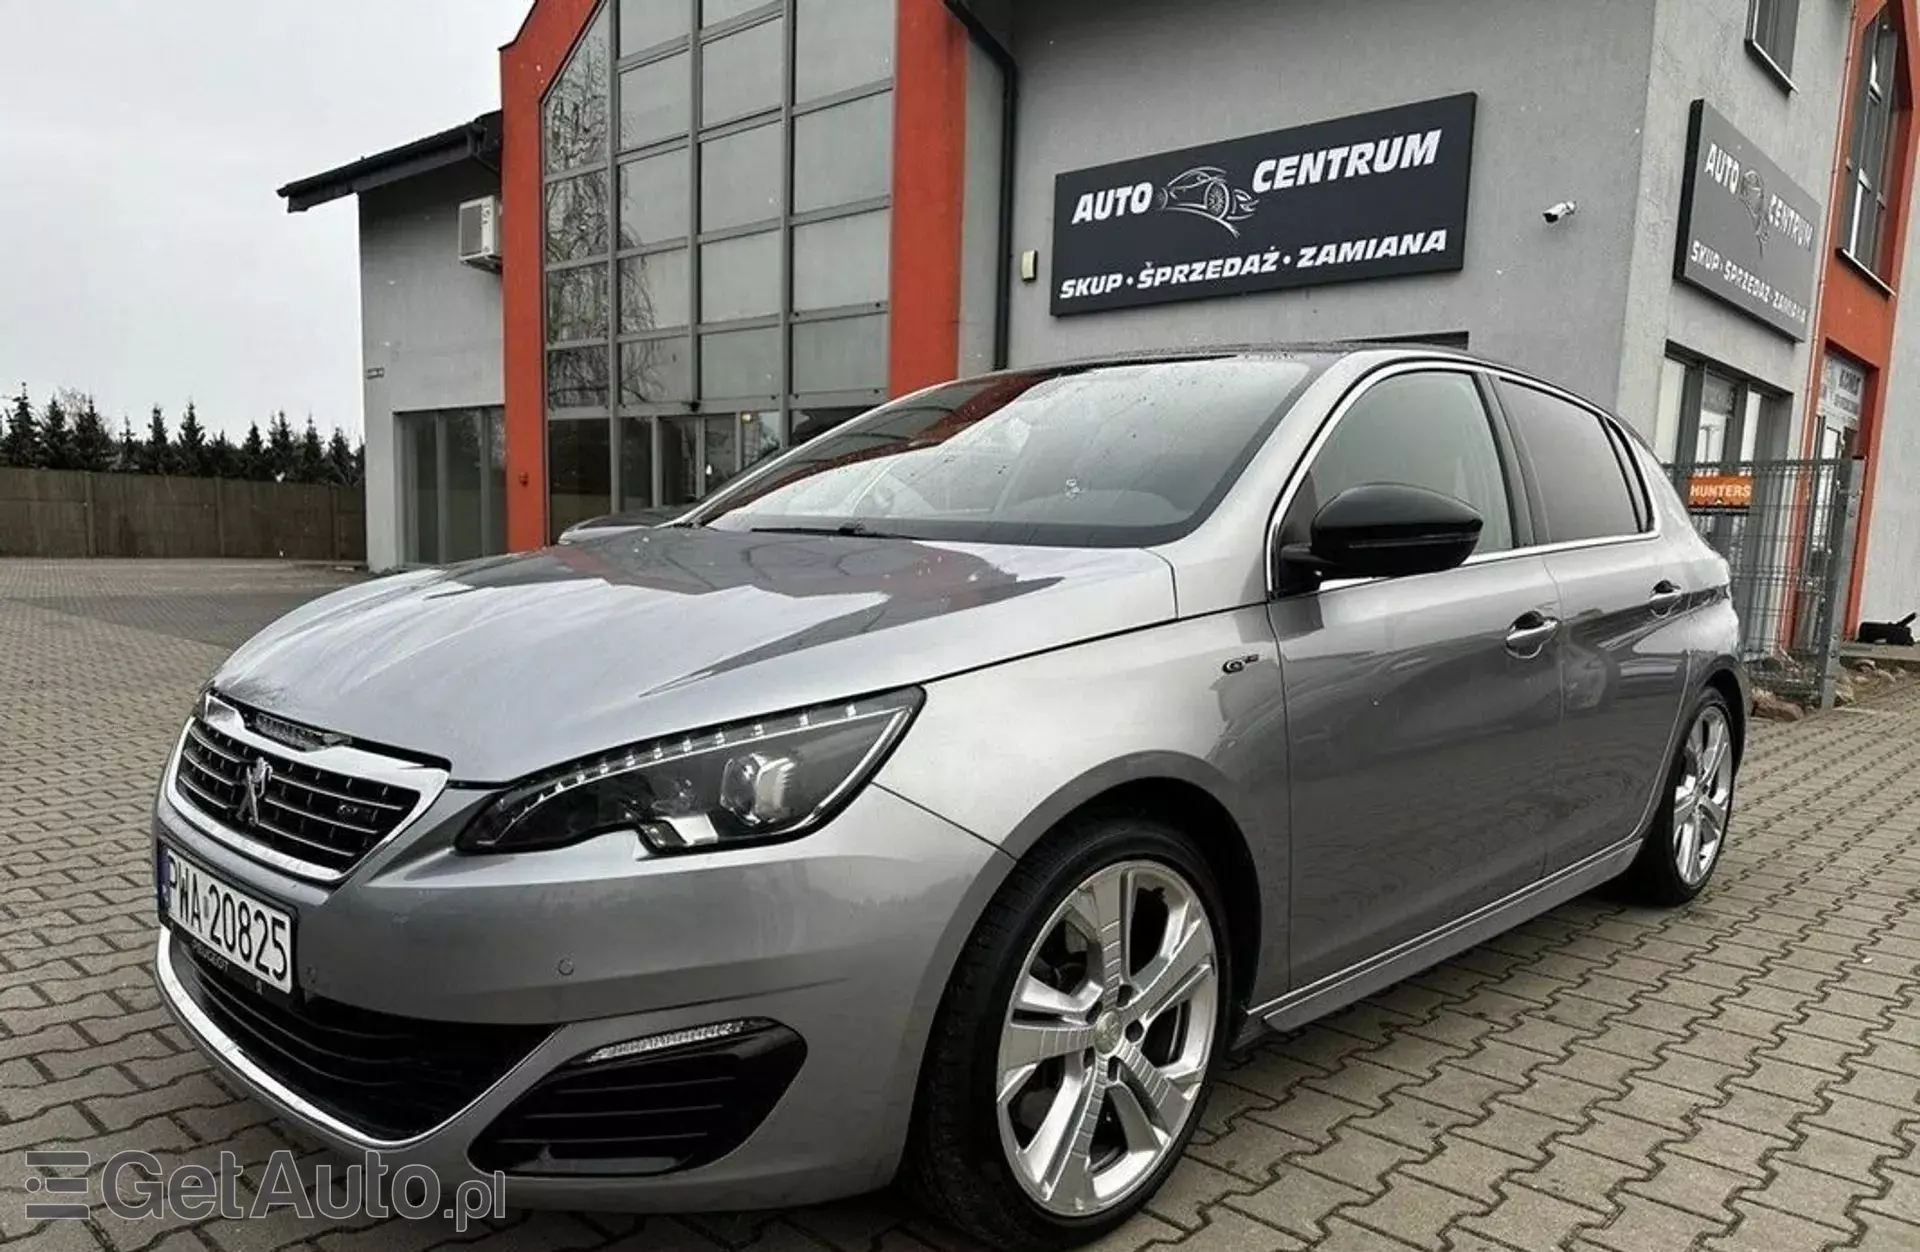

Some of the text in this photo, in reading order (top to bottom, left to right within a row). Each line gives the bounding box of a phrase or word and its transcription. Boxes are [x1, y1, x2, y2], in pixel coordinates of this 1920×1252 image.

[1071, 129, 1442, 225] AUTO CENTRUM
[1704, 143, 1814, 249] AUTO CENTRUM
[1060, 273, 1123, 299] SKUP
[1296, 229, 1447, 268] ZAMIANA
[1689, 484, 1752, 498] HUNTERS
[168, 855, 288, 981] PWA 20825
